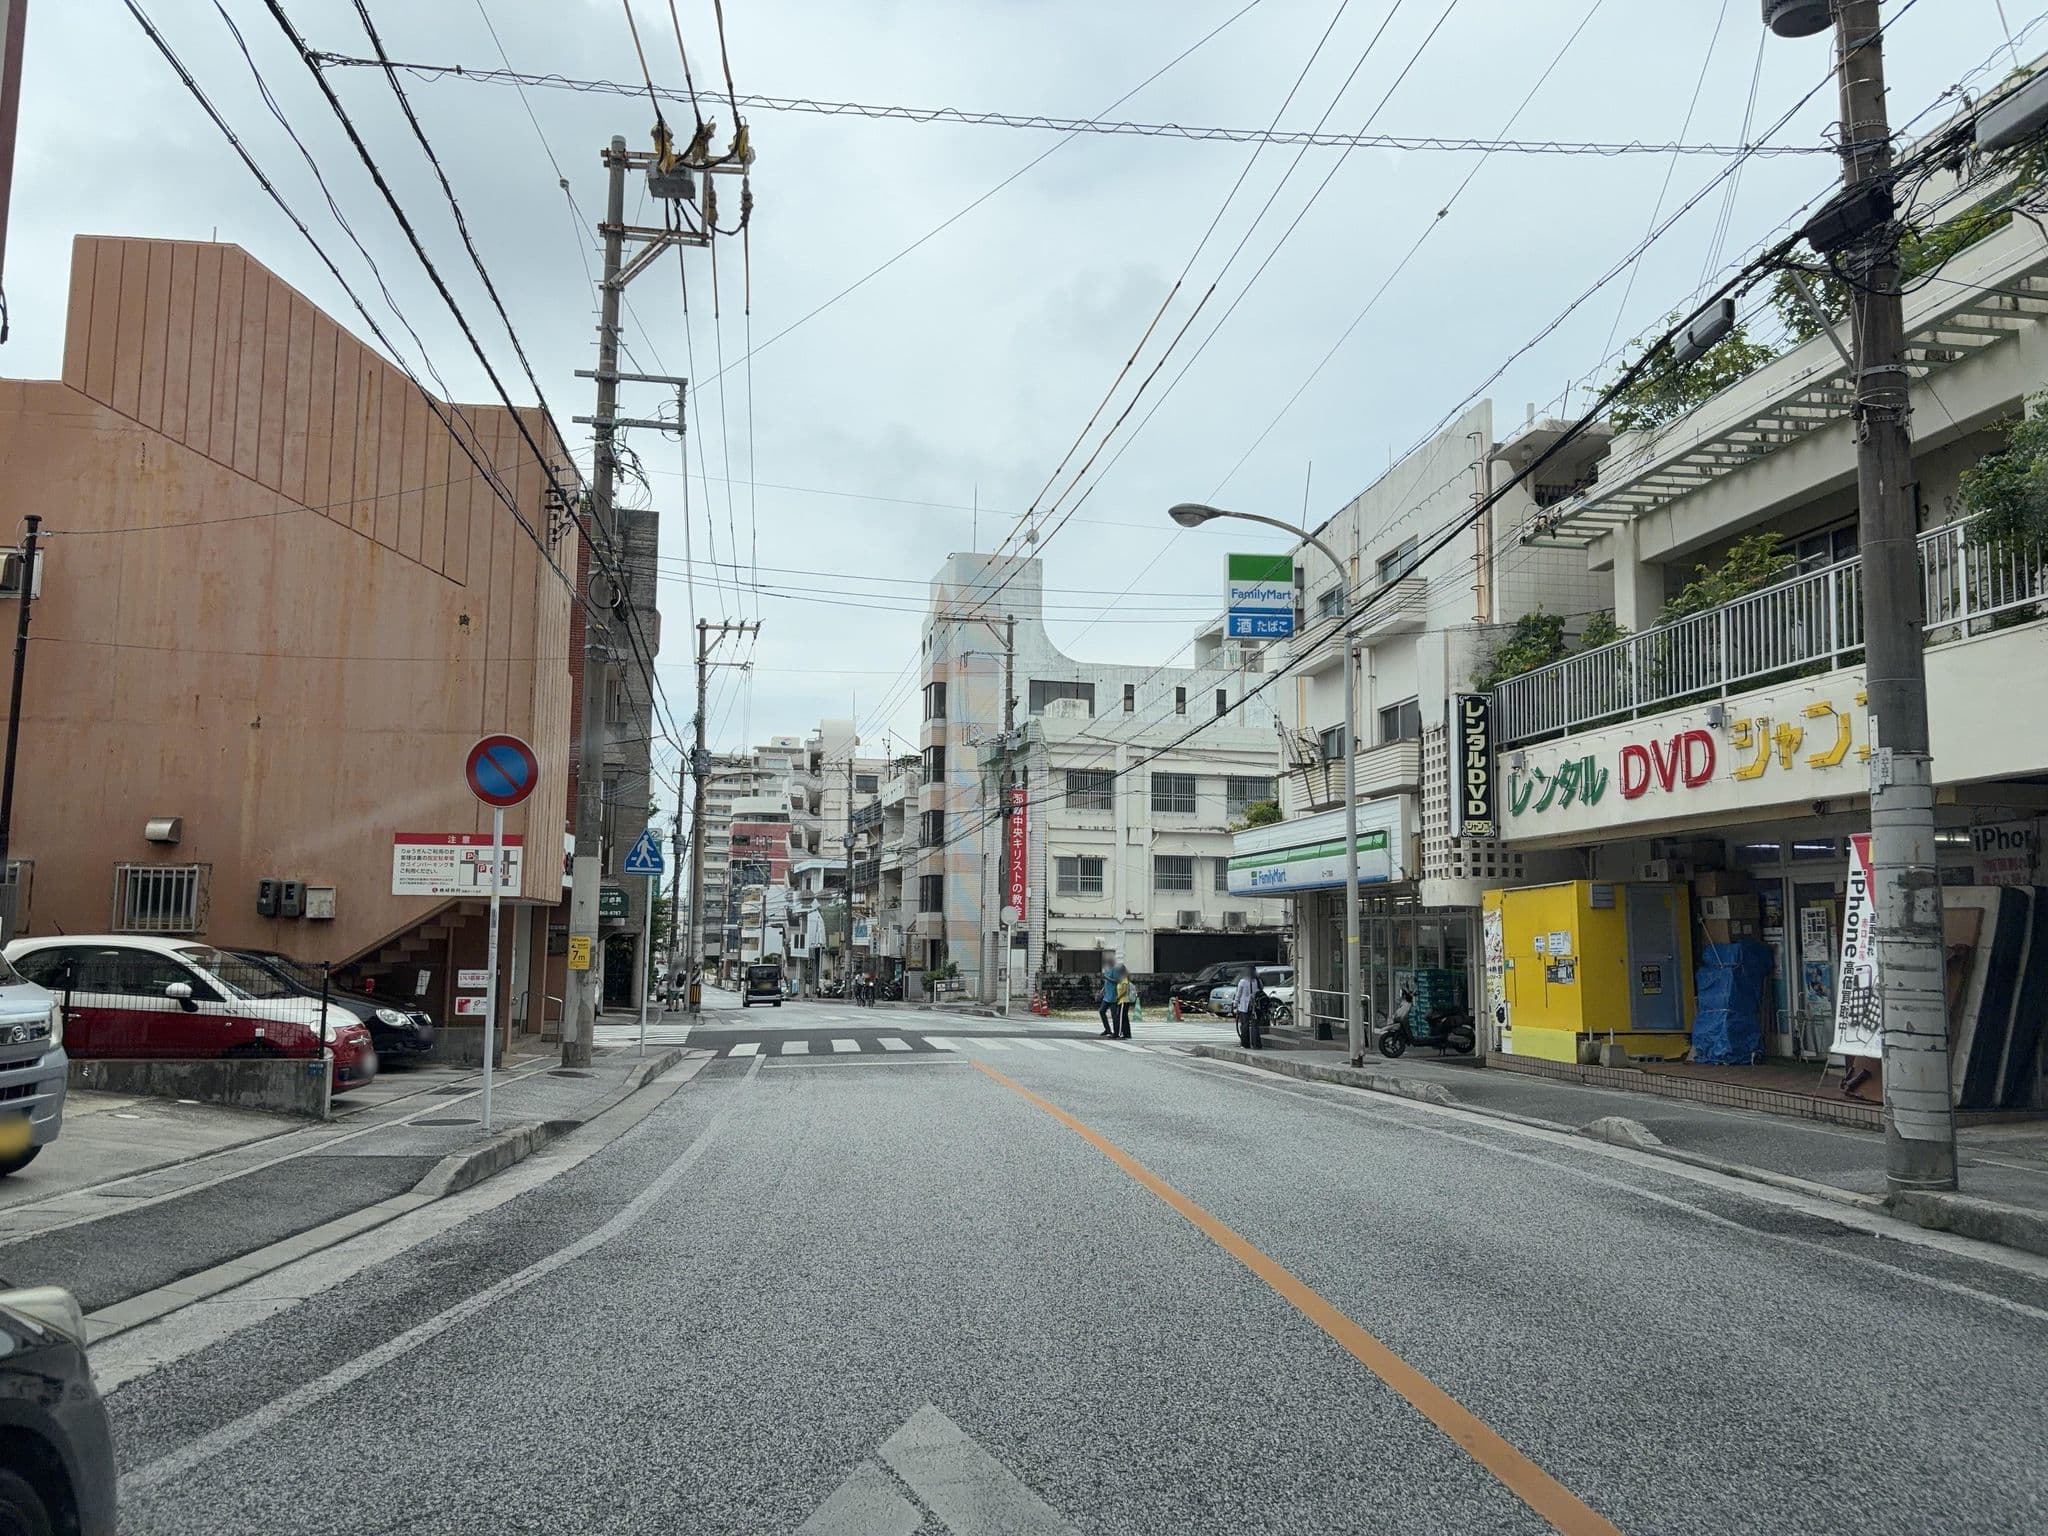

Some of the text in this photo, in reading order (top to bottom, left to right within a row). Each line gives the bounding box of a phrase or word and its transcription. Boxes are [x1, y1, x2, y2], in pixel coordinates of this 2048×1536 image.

[1231, 588, 1292, 601] FamilyMart
[1236, 618, 1289, 633] 酒 たばこ
[1465, 700, 1487, 815] レンタルDVD
[1508, 692, 1869, 817] レンタル DVD ジャン
[1258, 868, 1287, 885] FamilyMart
[1844, 870, 1867, 958] iPhone
